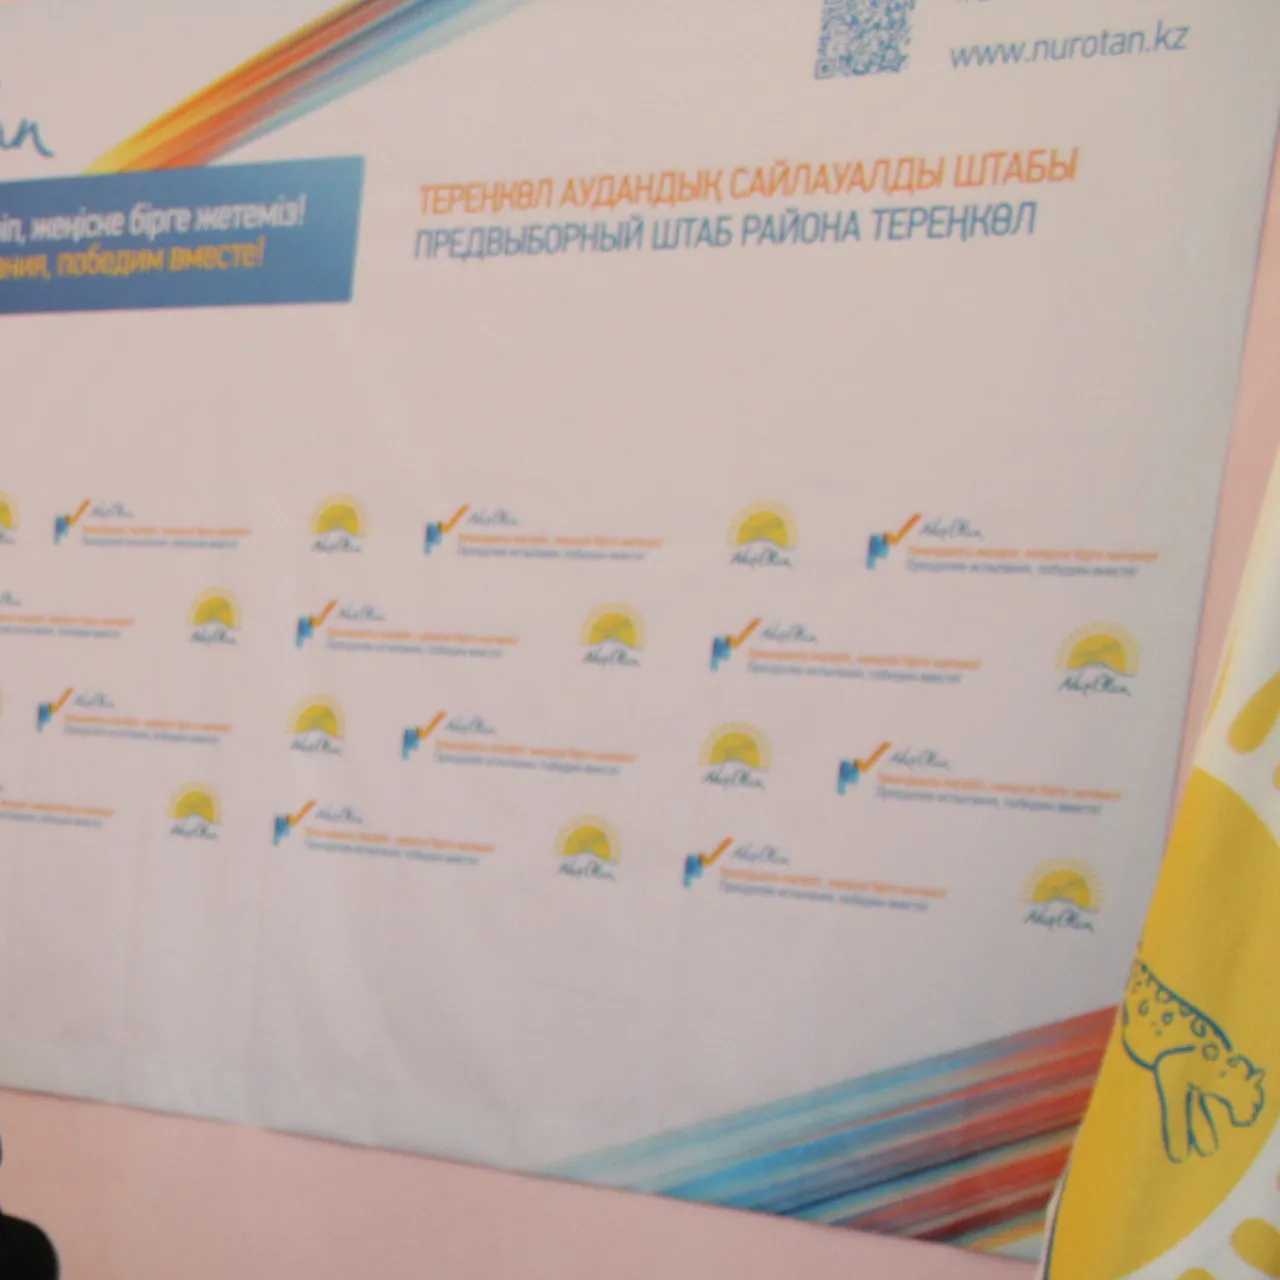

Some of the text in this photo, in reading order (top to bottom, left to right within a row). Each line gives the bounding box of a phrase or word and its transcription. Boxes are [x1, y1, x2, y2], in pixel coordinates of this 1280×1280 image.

[950, 19, 1191, 70] www.nurotan.kz
[729, 154, 947, 200] САЙЛАУАЛДЫ
[953, 145, 1080, 189] ШТАБЫ
[414, 200, 1038, 261] ПРЕДВЫБОРНЫЙ ШТАБ РАЙОНА ТЕРЕҢКӨЛ
